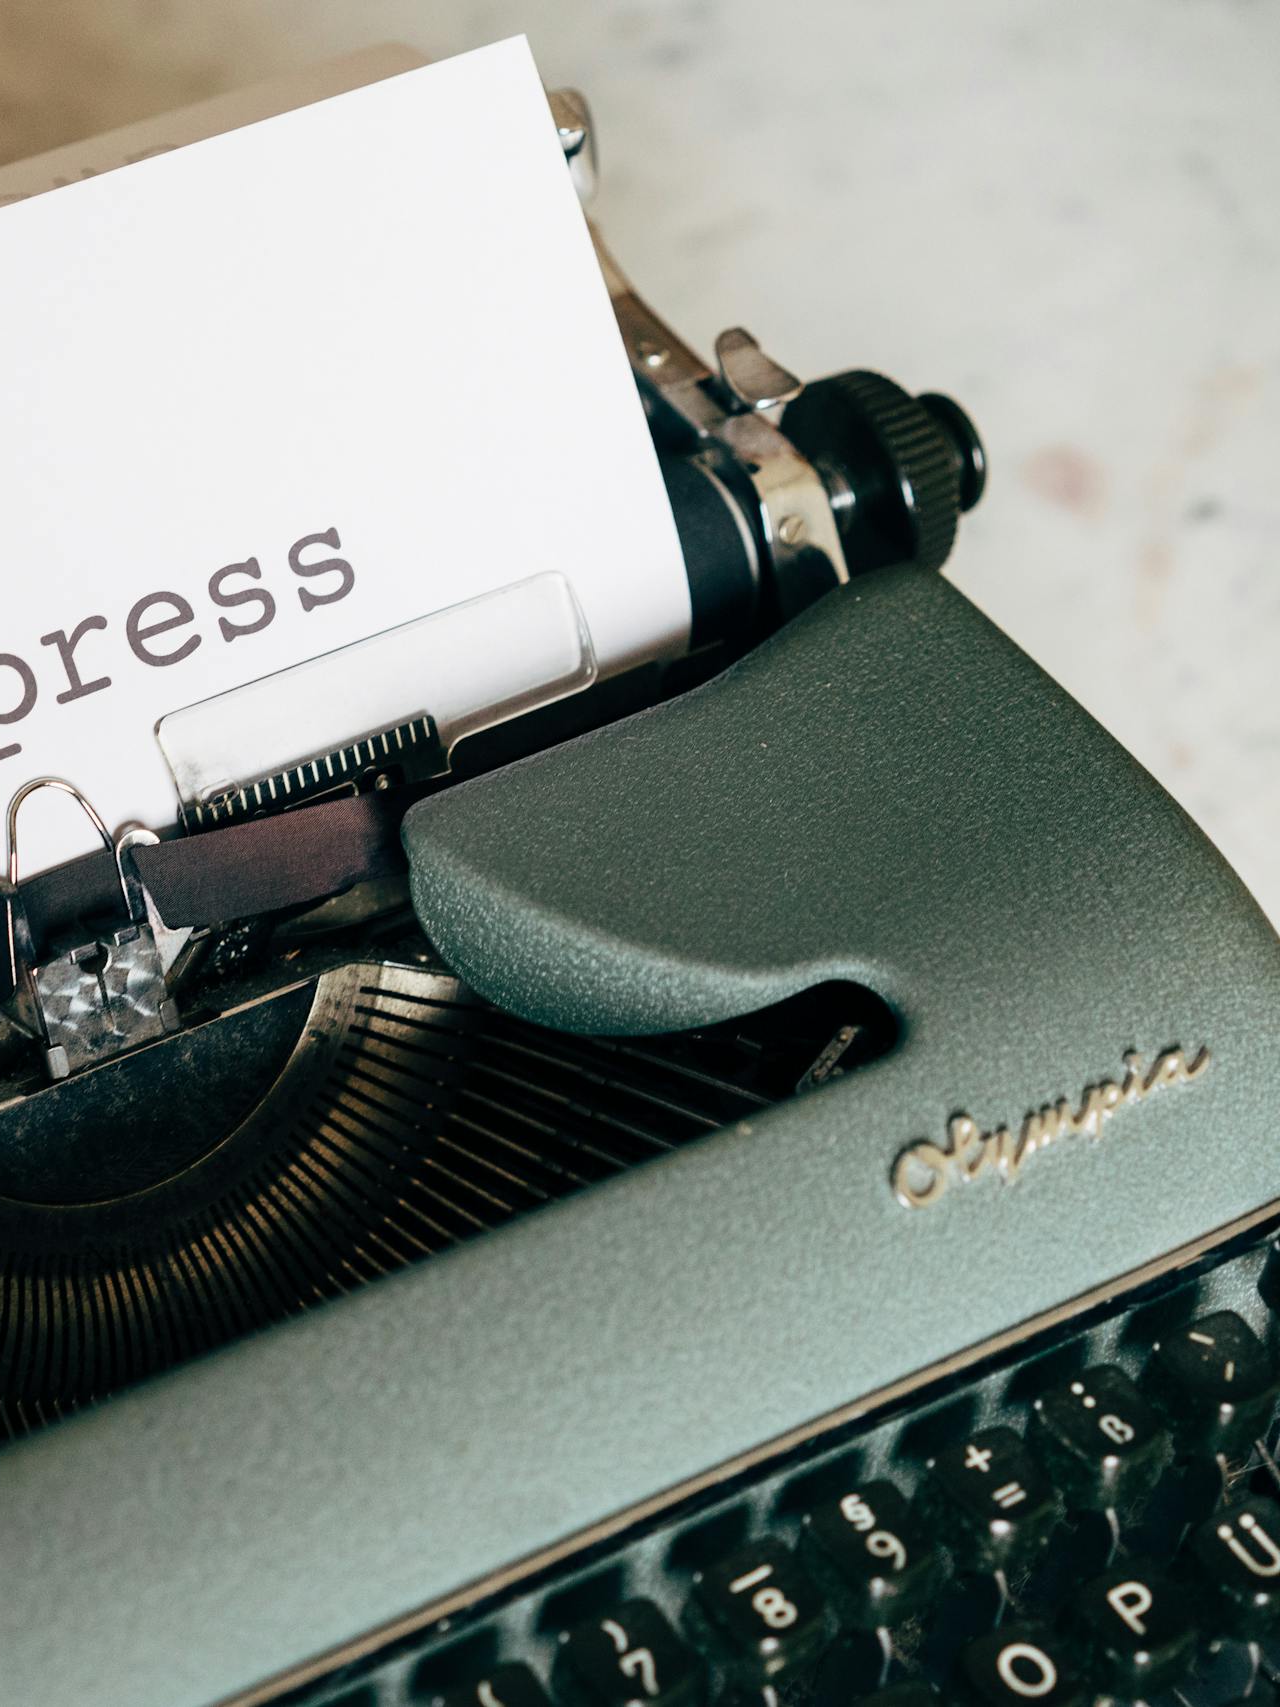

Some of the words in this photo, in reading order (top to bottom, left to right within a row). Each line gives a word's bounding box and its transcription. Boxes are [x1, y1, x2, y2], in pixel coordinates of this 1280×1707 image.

[894, 1044, 1211, 1209] Olympia
[866, 1530, 907, 1571] 9
[752, 1587, 798, 1629] 8
[1106, 1580, 1153, 1635] P
[620, 1648, 659, 1696] 7
